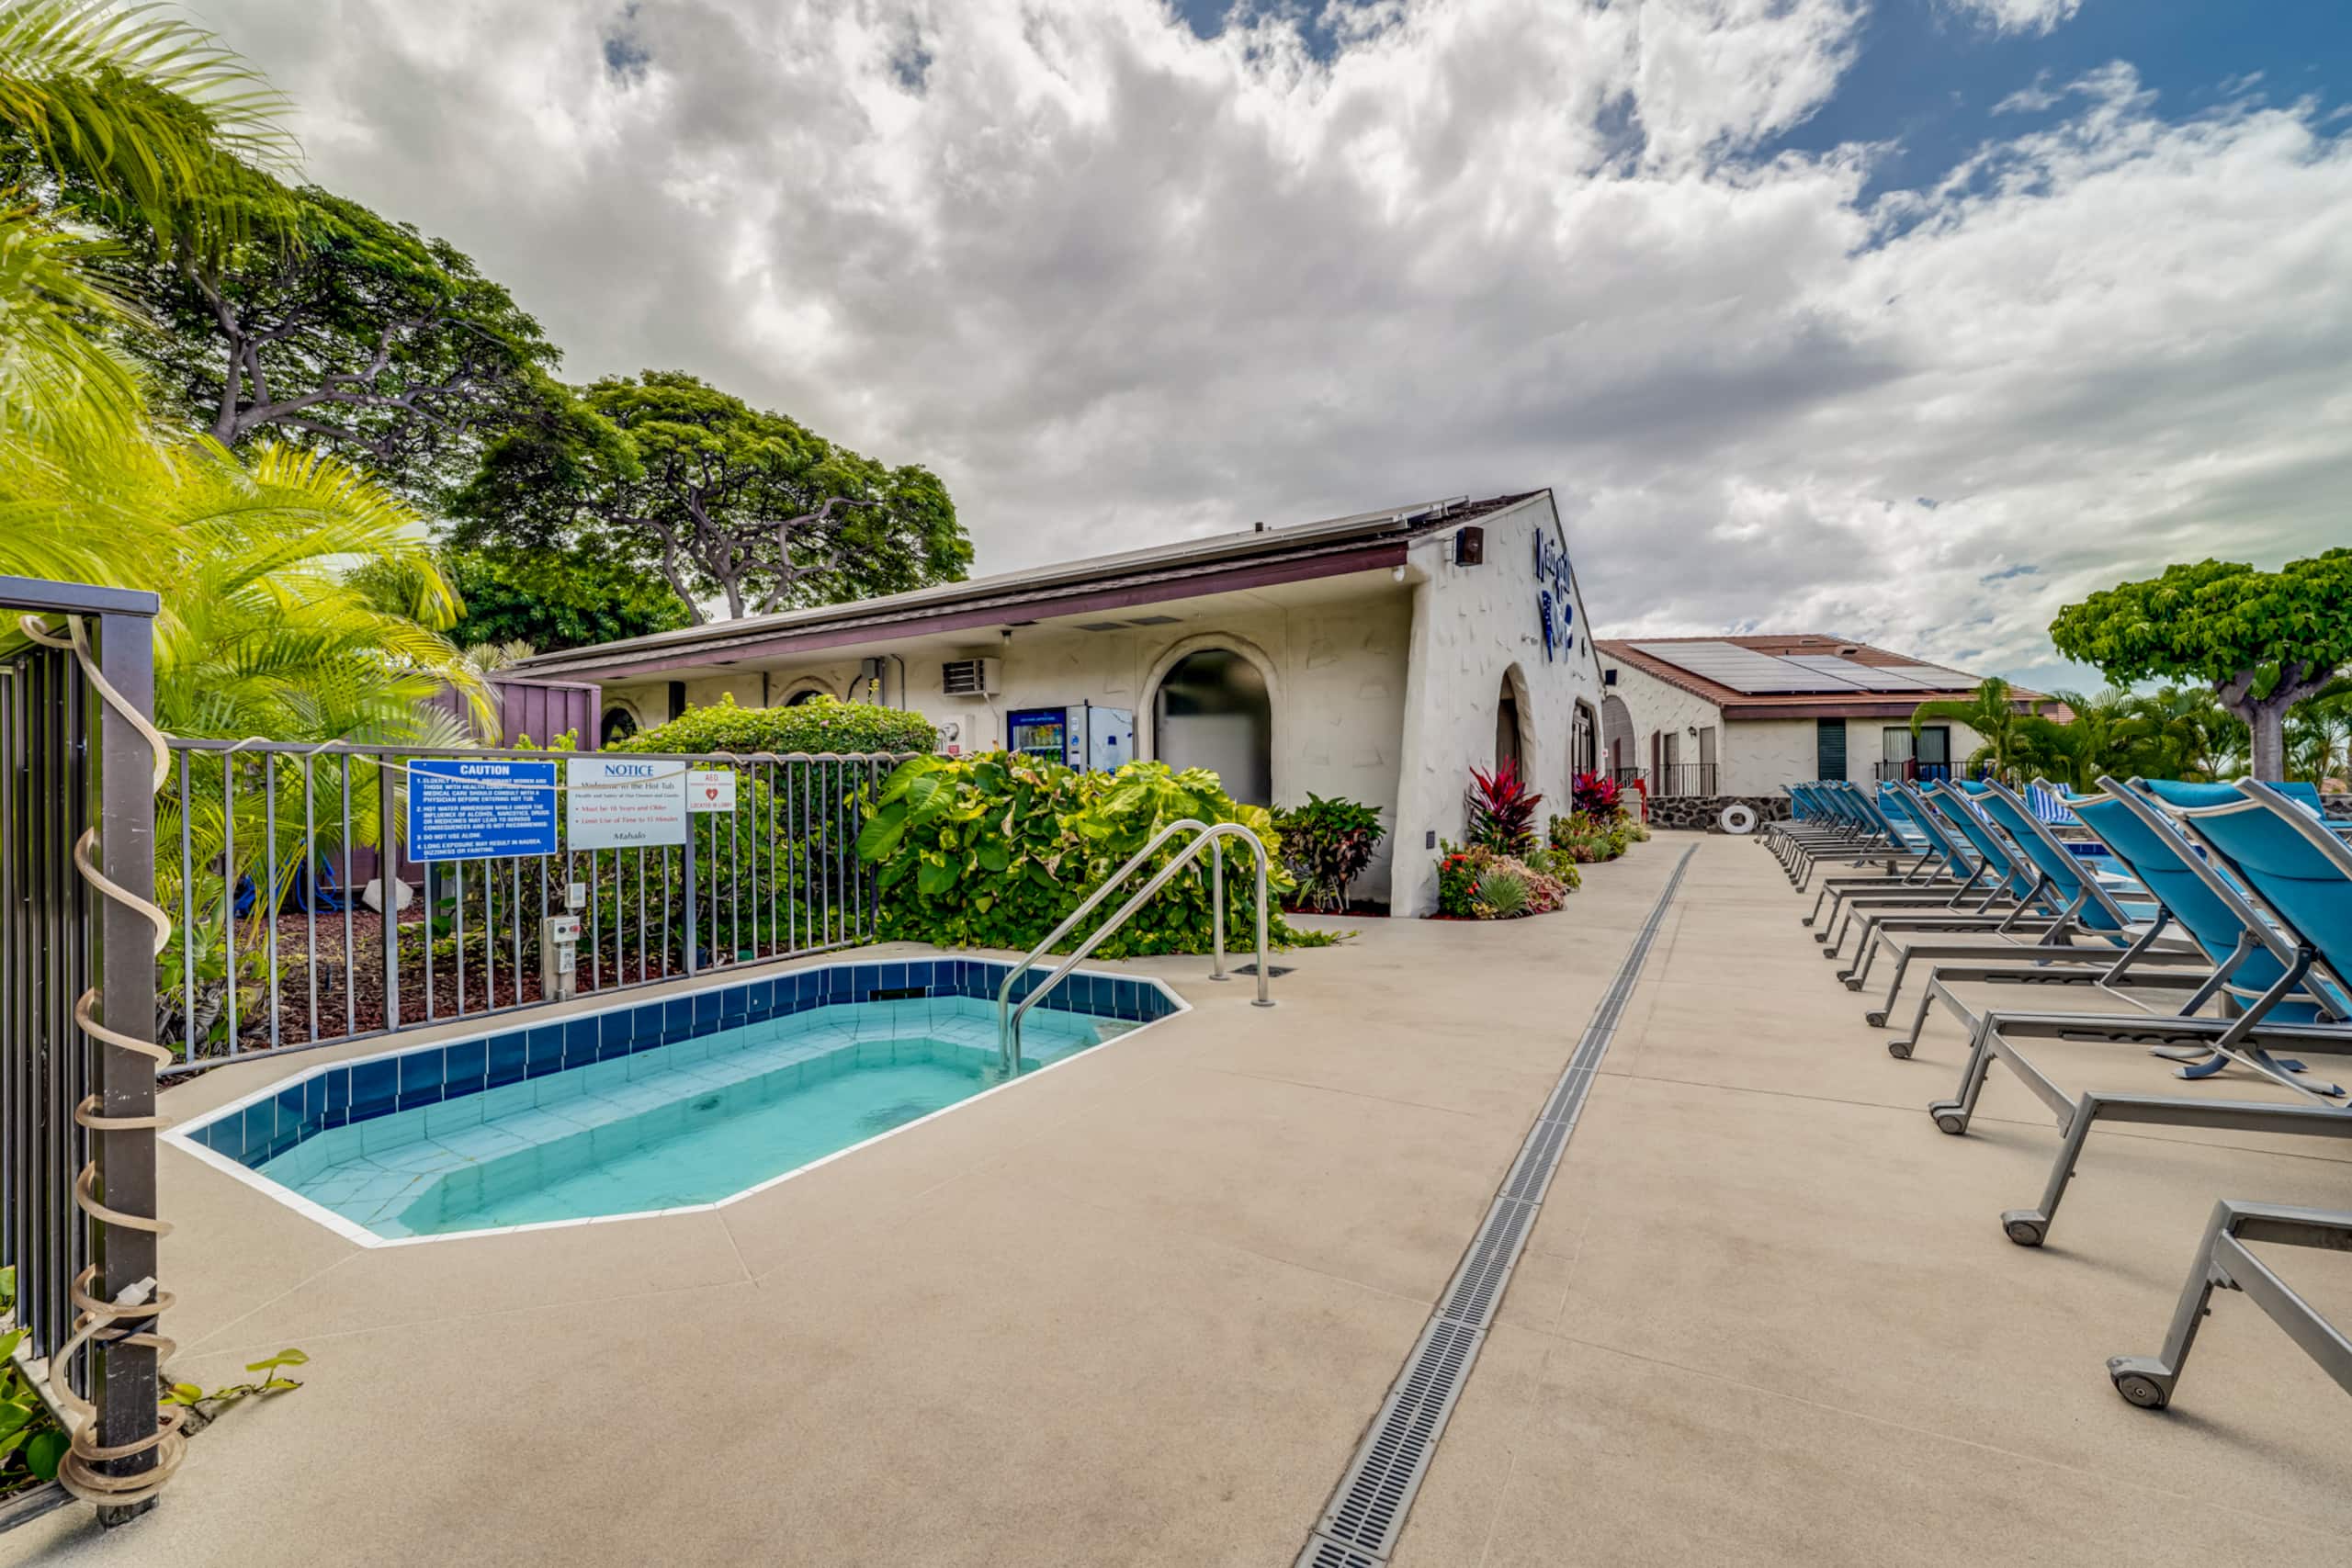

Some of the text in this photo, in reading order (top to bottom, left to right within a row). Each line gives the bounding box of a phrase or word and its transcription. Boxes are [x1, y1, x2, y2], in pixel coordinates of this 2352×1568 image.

[460, 764, 510, 775] CAUTION
[605, 764, 654, 776] NOTICE
[645, 782, 659, 790] Hot
[661, 782, 674, 790] Tub
[613, 831, 646, 840] Mahalo
